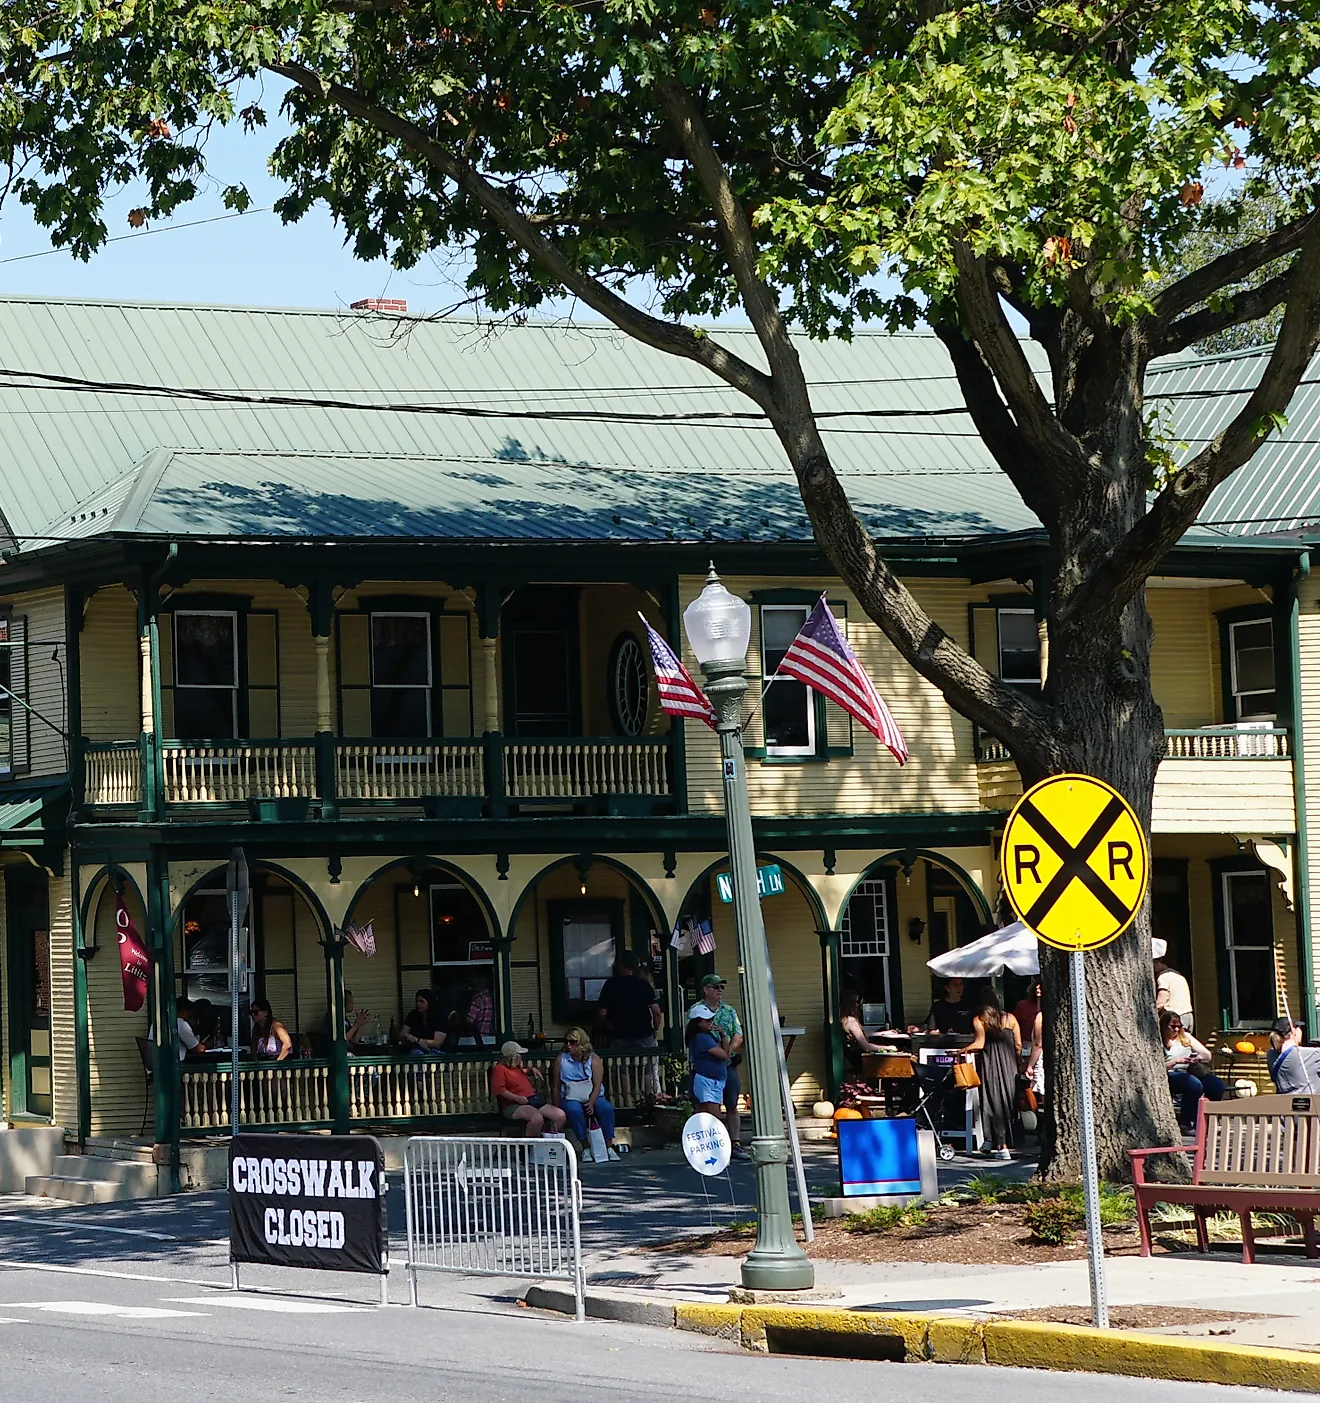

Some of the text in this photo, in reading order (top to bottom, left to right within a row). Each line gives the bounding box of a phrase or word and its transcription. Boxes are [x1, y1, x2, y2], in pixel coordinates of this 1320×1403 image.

[1014, 841, 1135, 884] R R
[769, 873, 783, 892] LN
[124, 962, 147, 981] Lititz
[686, 1128, 722, 1142] FESTIVAL
[690, 1139, 725, 1155] PARKING
[232, 1157, 376, 1198] CROSSWALK
[264, 1207, 345, 1249] CLOSED
